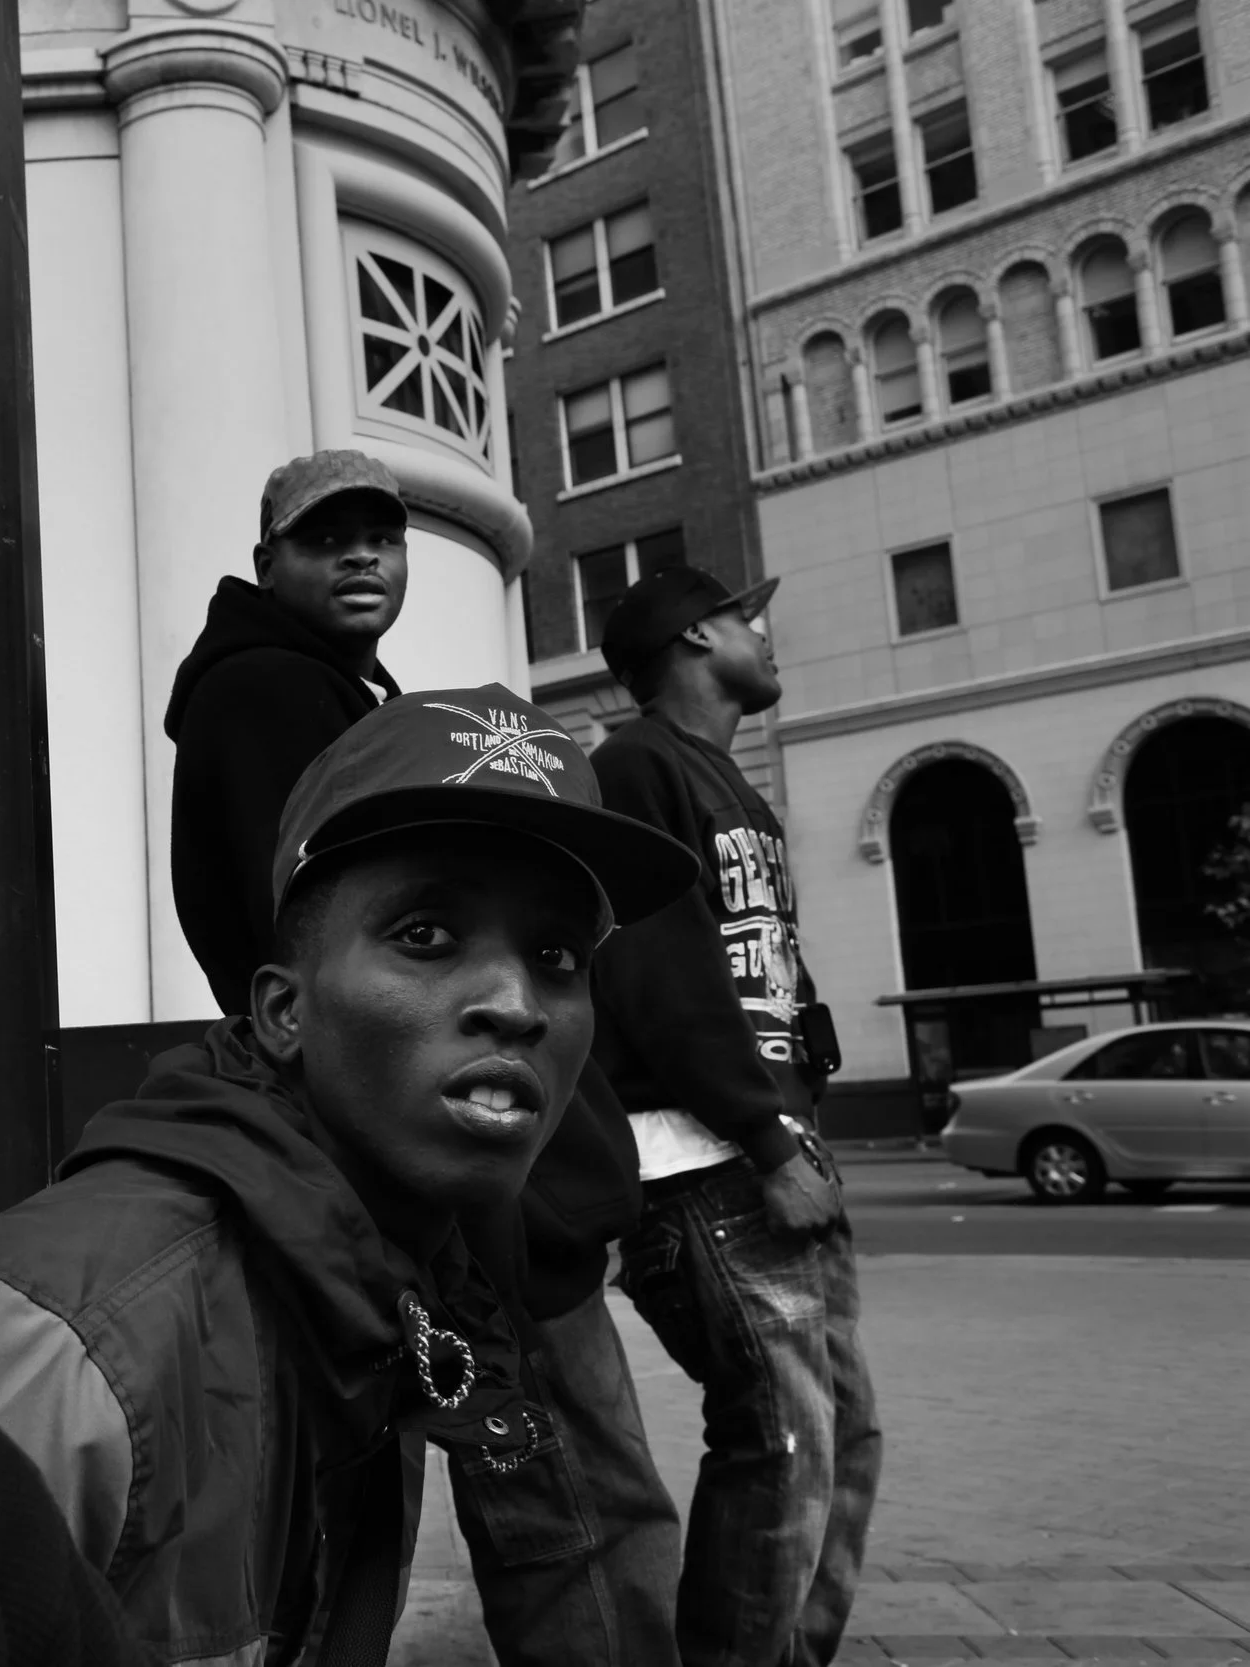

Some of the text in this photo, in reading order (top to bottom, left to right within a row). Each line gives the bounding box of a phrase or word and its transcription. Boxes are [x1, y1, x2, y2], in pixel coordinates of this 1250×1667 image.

[488, 708, 528, 732] VANS
[450, 732, 501, 752] PORTLAND
[521, 741, 565, 771] KAMAKURA
[489, 756, 540, 782] SEBASTIAN
